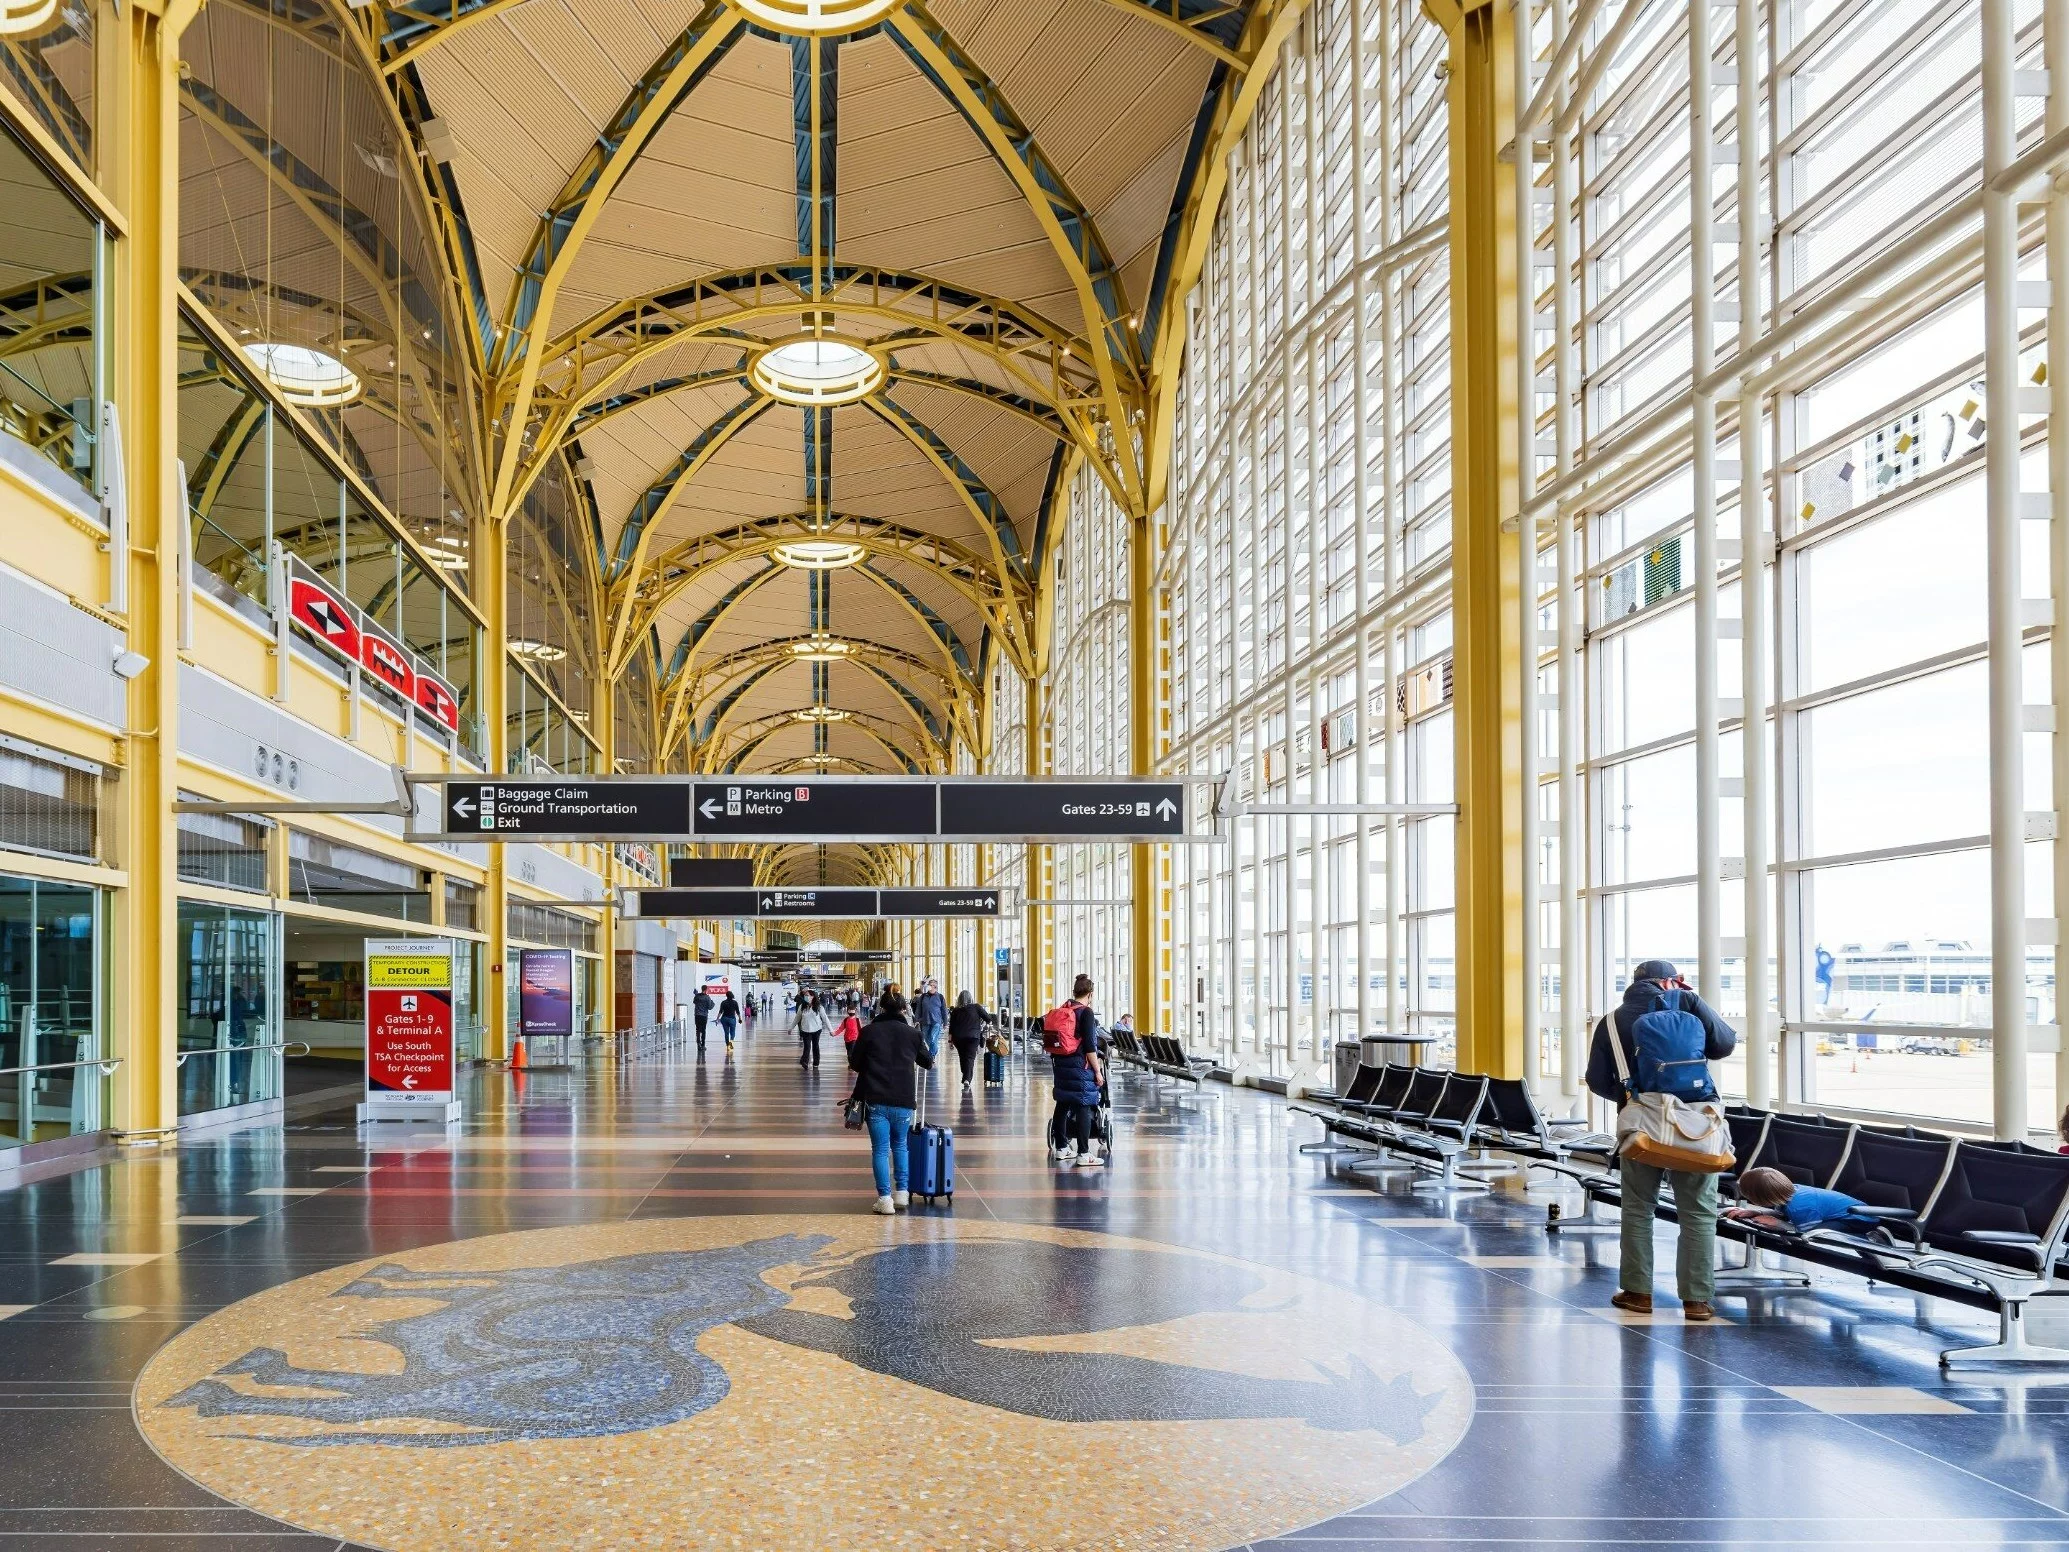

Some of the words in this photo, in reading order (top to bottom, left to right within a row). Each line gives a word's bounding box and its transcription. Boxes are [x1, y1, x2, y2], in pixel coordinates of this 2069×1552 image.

[498, 788, 551, 801] Baggage
[554, 788, 589, 799] Claim
[730, 789, 737, 799] P
[745, 788, 792, 802] Parking
[798, 789, 806, 799] B
[498, 802, 545, 814] Ground
[547, 802, 638, 816] Transportation
[745, 803, 783, 814] Metro
[1061, 803, 1097, 815] Gates
[1099, 803, 1133, 815] 23-59
[498, 817, 521, 828] Exit
[388, 967, 430, 975] DETOUR
[384, 1014, 414, 1024] Gates
[416, 1014, 434, 1024] 1-9
[376, 1025, 384, 1035] &
[387, 1025, 432, 1035] Terminal
[434, 1026, 443, 1035] A
[387, 1042, 404, 1050] Use
[405, 1041, 432, 1050] South
[374, 1052, 392, 1061] TSA
[393, 1052, 445, 1063] Checkpoint
[387, 1063, 401, 1072] for
[403, 1064, 432, 1073] Access
